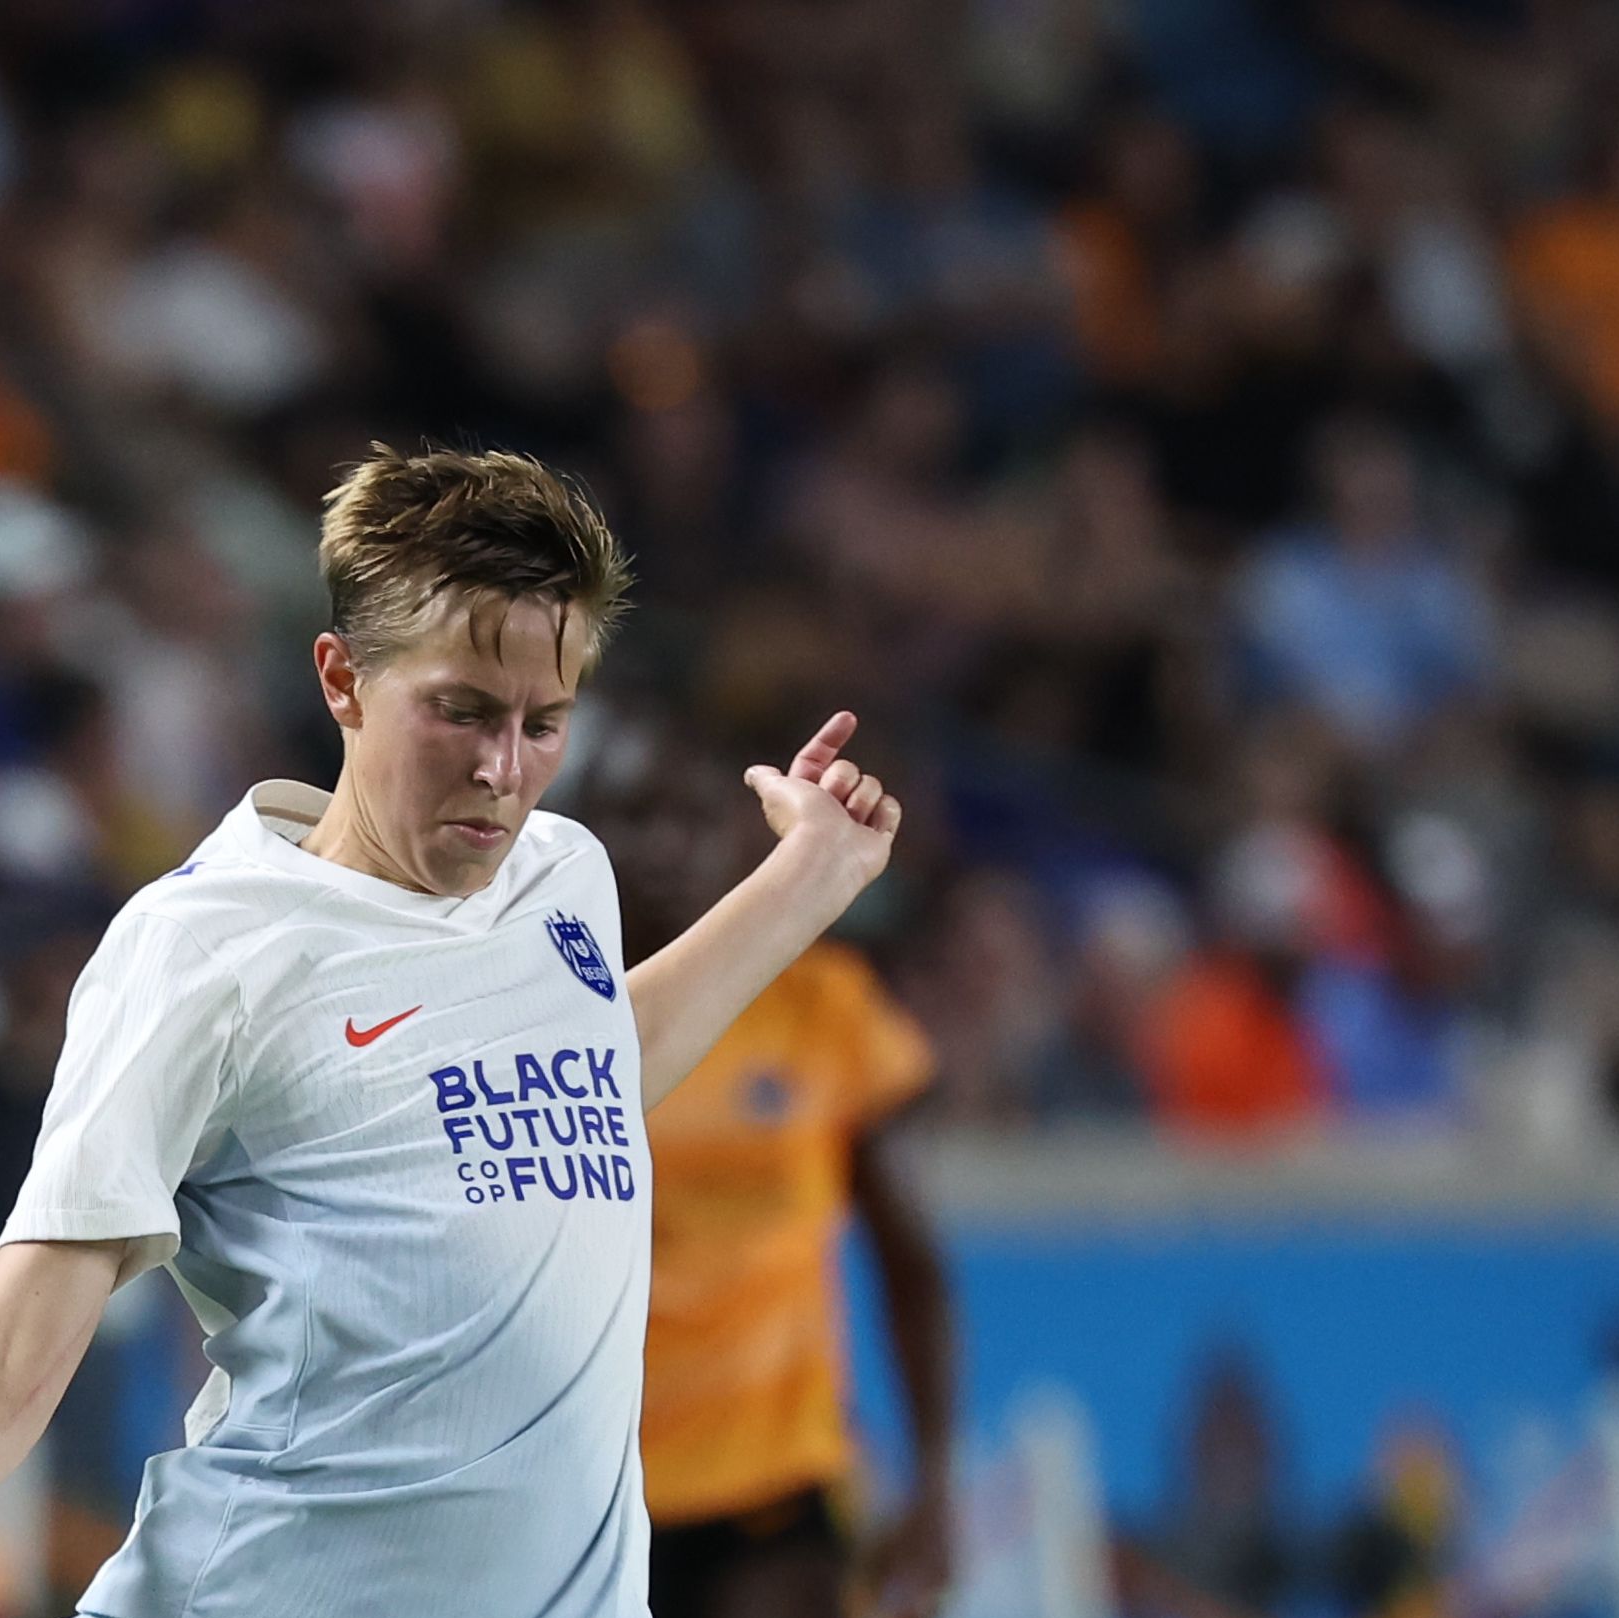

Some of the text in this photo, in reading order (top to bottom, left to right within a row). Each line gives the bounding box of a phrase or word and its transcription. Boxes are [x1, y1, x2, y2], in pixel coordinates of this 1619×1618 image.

[428, 1048, 621, 1113] BLACK
[442, 1106, 629, 1154] FUTURE
[457, 1160, 499, 1182] CO
[465, 1184, 506, 1204] OP
[505, 1154, 635, 1202] FUND
